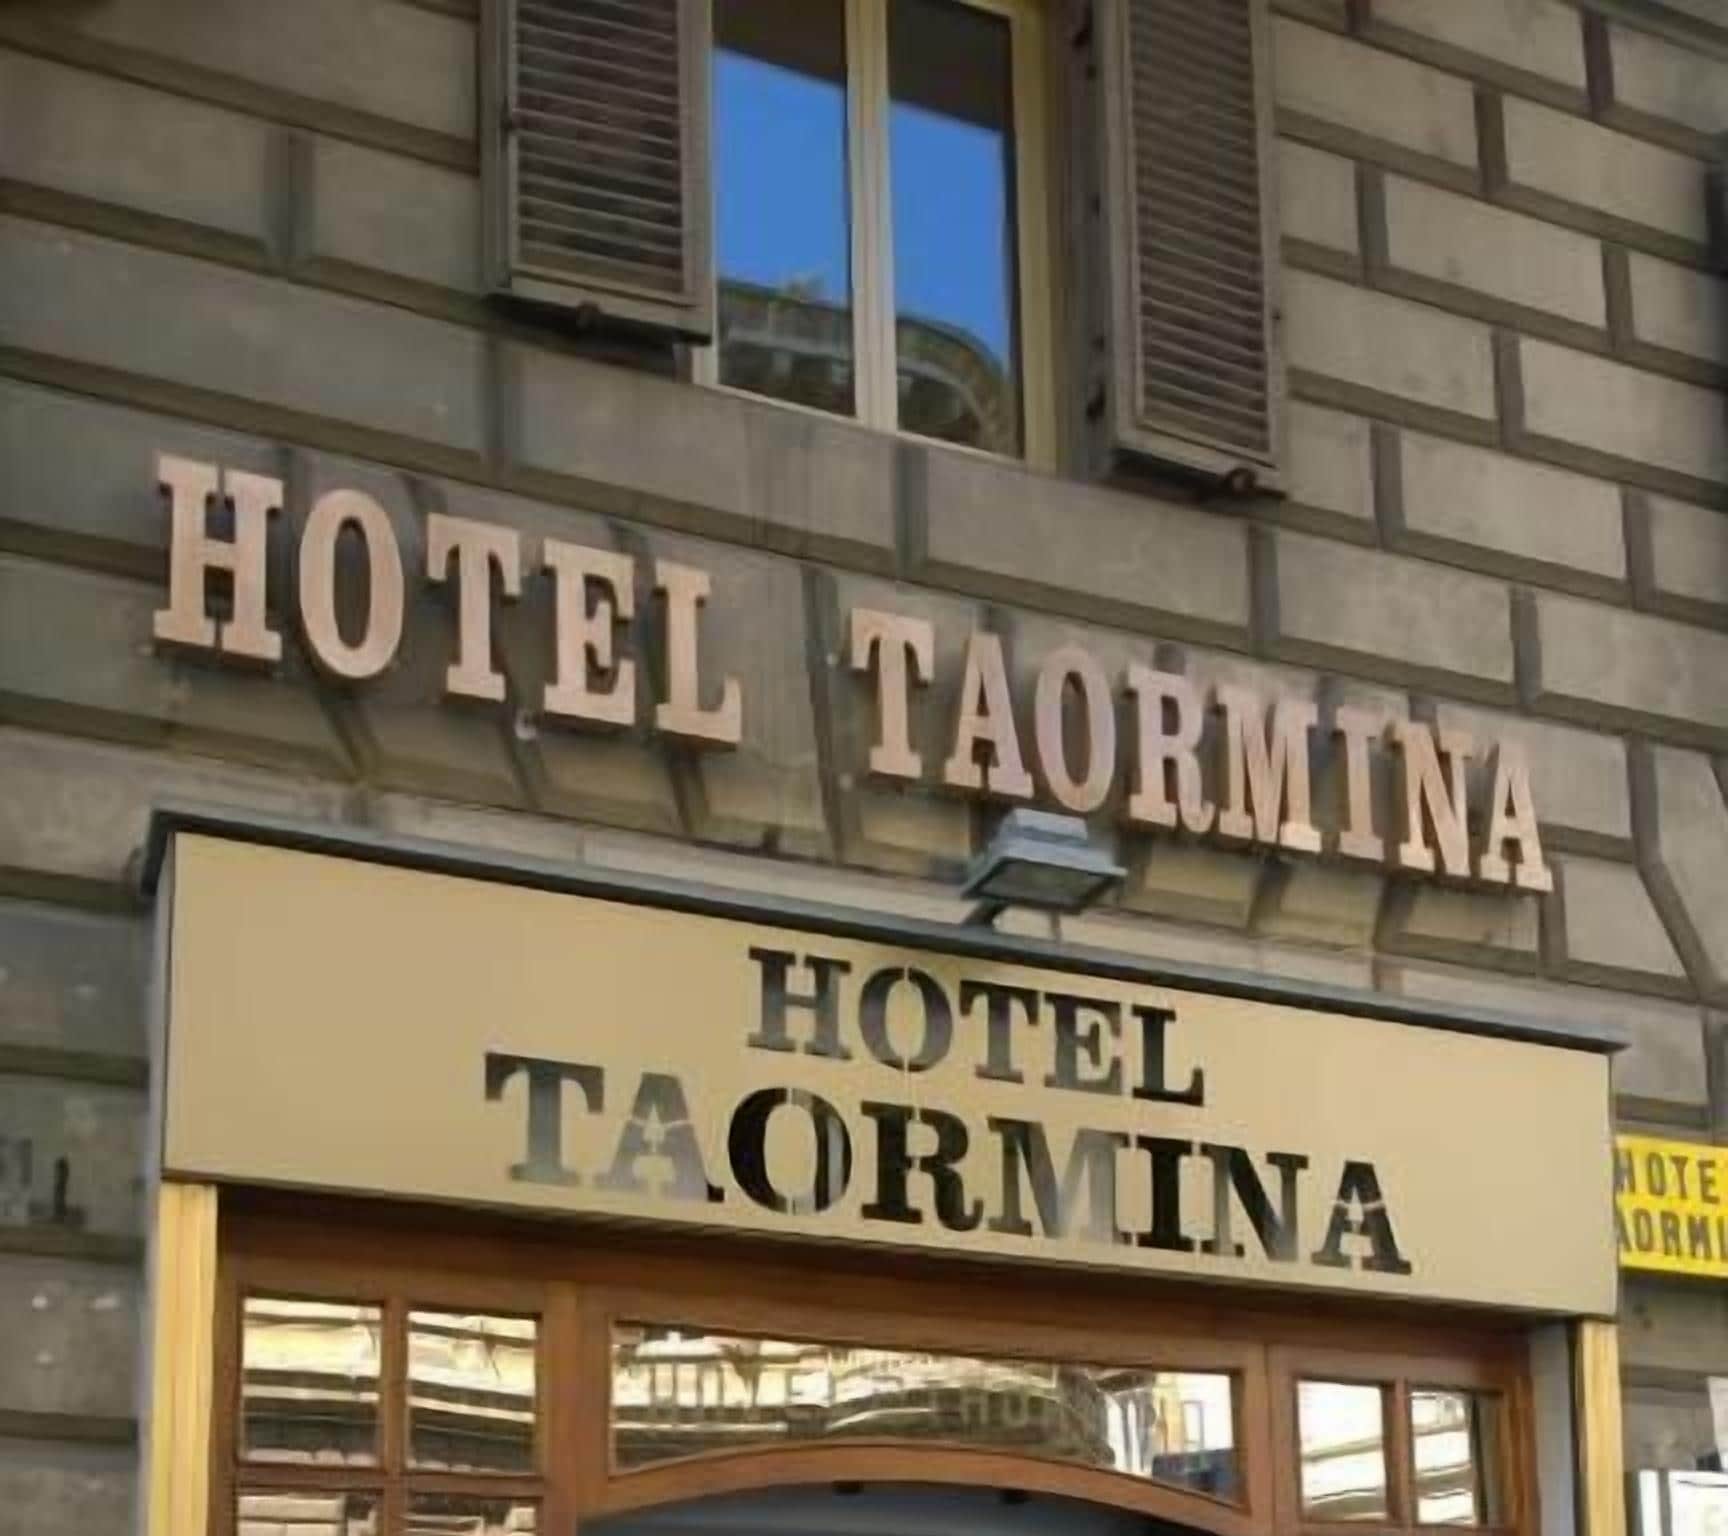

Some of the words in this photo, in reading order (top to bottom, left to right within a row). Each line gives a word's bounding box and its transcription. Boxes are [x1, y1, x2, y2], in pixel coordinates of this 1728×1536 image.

[152, 454, 743, 743] HOTEL
[850, 607, 1554, 892] TAORMINA
[746, 945, 1206, 1107] HOTEL
[484, 1051, 1413, 1276] TAORMINA
